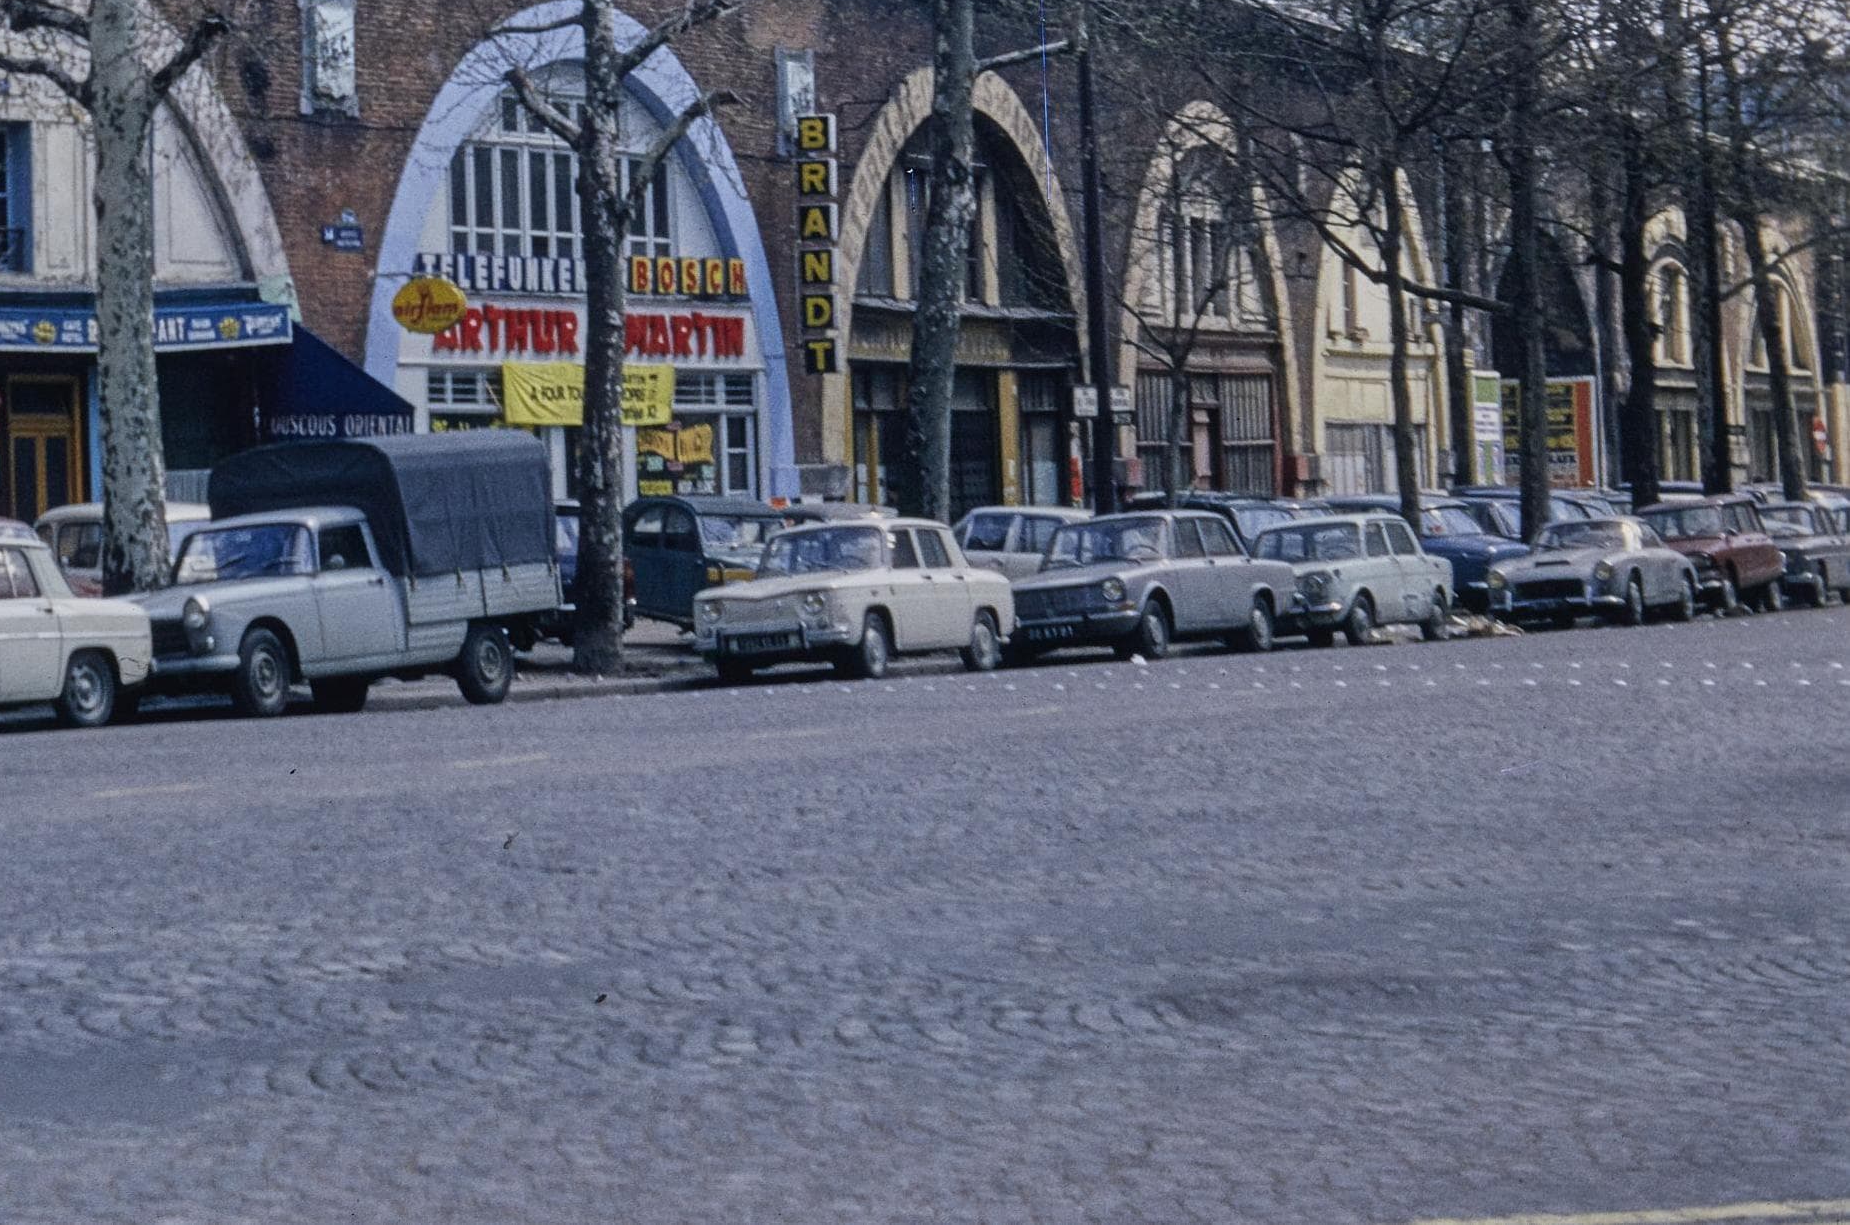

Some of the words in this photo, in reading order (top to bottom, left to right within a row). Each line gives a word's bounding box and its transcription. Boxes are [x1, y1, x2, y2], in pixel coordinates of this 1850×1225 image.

[800, 118, 832, 372] BRANDT
[636, 259, 746, 292] BOSCH
[624, 311, 745, 357] MARTIN
[268, 413, 337, 437] OUSCOUS
